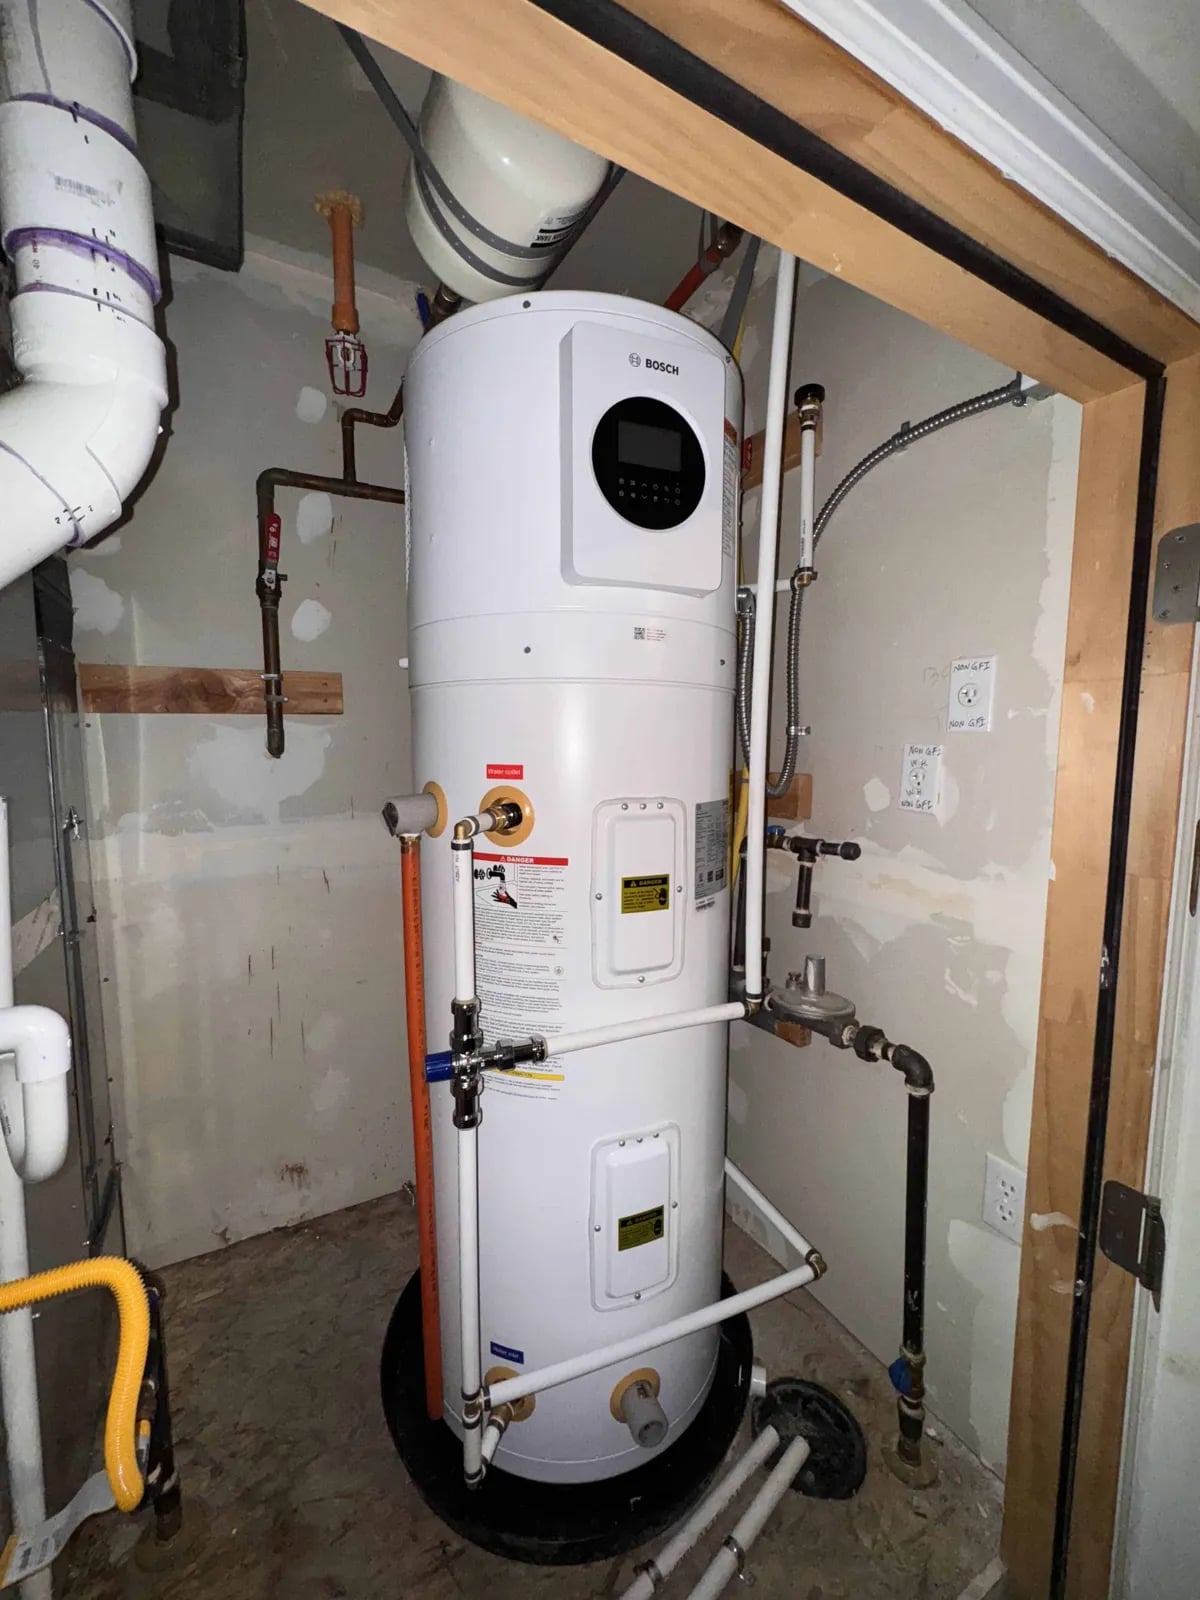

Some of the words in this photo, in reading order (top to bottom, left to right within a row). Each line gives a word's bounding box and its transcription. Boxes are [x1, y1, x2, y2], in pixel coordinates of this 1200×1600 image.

[645, 358, 679, 376] BOSCH
[953, 662, 971, 672] NON
[971, 661, 990, 671] GFI
[949, 719, 965, 729] NON
[968, 716, 986, 728] GFI
[908, 745, 924, 756] NON
[925, 746, 942, 756] GFI
[506, 856, 534, 864] DANGER
